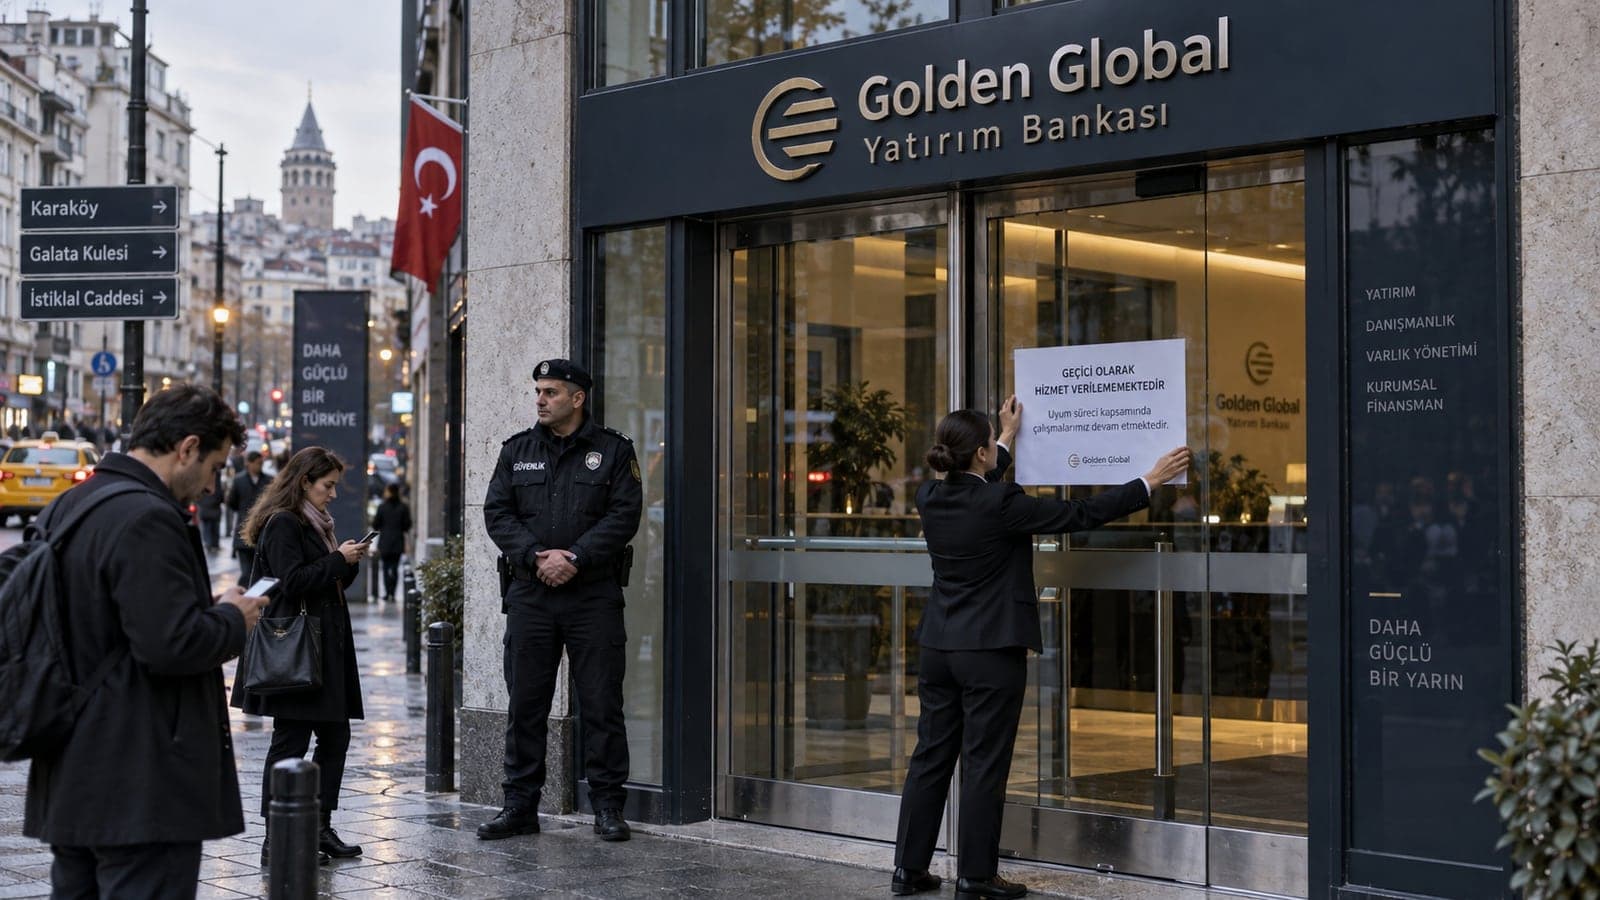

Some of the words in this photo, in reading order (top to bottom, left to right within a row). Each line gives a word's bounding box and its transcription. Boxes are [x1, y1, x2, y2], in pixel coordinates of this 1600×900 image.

[857, 59, 1031, 121] Golden
[1049, 16, 1229, 93] Global
[864, 125, 1001, 164] Yatırım
[1023, 102, 1168, 145] Bankası
[31, 200, 99, 219] Karaköy
[30, 245, 78, 262] Galata
[83, 244, 128, 261] Kulesi
[31, 288, 80, 307] İstiklal
[84, 289, 144, 306] Caddesi
[1366, 286, 1416, 301] YATIRIM
[1366, 314, 1455, 332] DANIŞMANLIK
[303, 343, 341, 358] DAHA
[1366, 348, 1411, 362] VARLIK
[1414, 341, 1477, 360] YÖNETİMİ
[302, 364, 348, 384] GÜÇLÜ
[1062, 365, 1093, 379] GEÇİCİ
[1095, 364, 1135, 377] OLARAK
[1035, 383, 1069, 396] HİZMET
[1071, 378, 1165, 394] VERİLEMEMEKTEDİR
[1367, 378, 1438, 393] KURUMSAL
[302, 387, 325, 404] BİR
[1216, 393, 1260, 412] Golden
[1263, 396, 1300, 414] Global
[1048, 409, 1072, 420] Uyum
[1074, 407, 1098, 418] süreci
[1100, 405, 1152, 419] kapsamında
[1367, 398, 1444, 413] FİNANSMAN
[301, 410, 357, 426] TÜRKİYE
[1033, 422, 1089, 435] çalışmalarımız
[1091, 422, 1119, 432] devam
[1121, 419, 1169, 431] etmektedir.
[1082, 456, 1106, 464] Golden
[1108, 455, 1130, 464] Global
[1369, 619, 1422, 636] DAHA
[1369, 641, 1432, 665] GÜÇLÜ
[1370, 667, 1400, 687] BİR
[1406, 672, 1463, 690] YARIN
